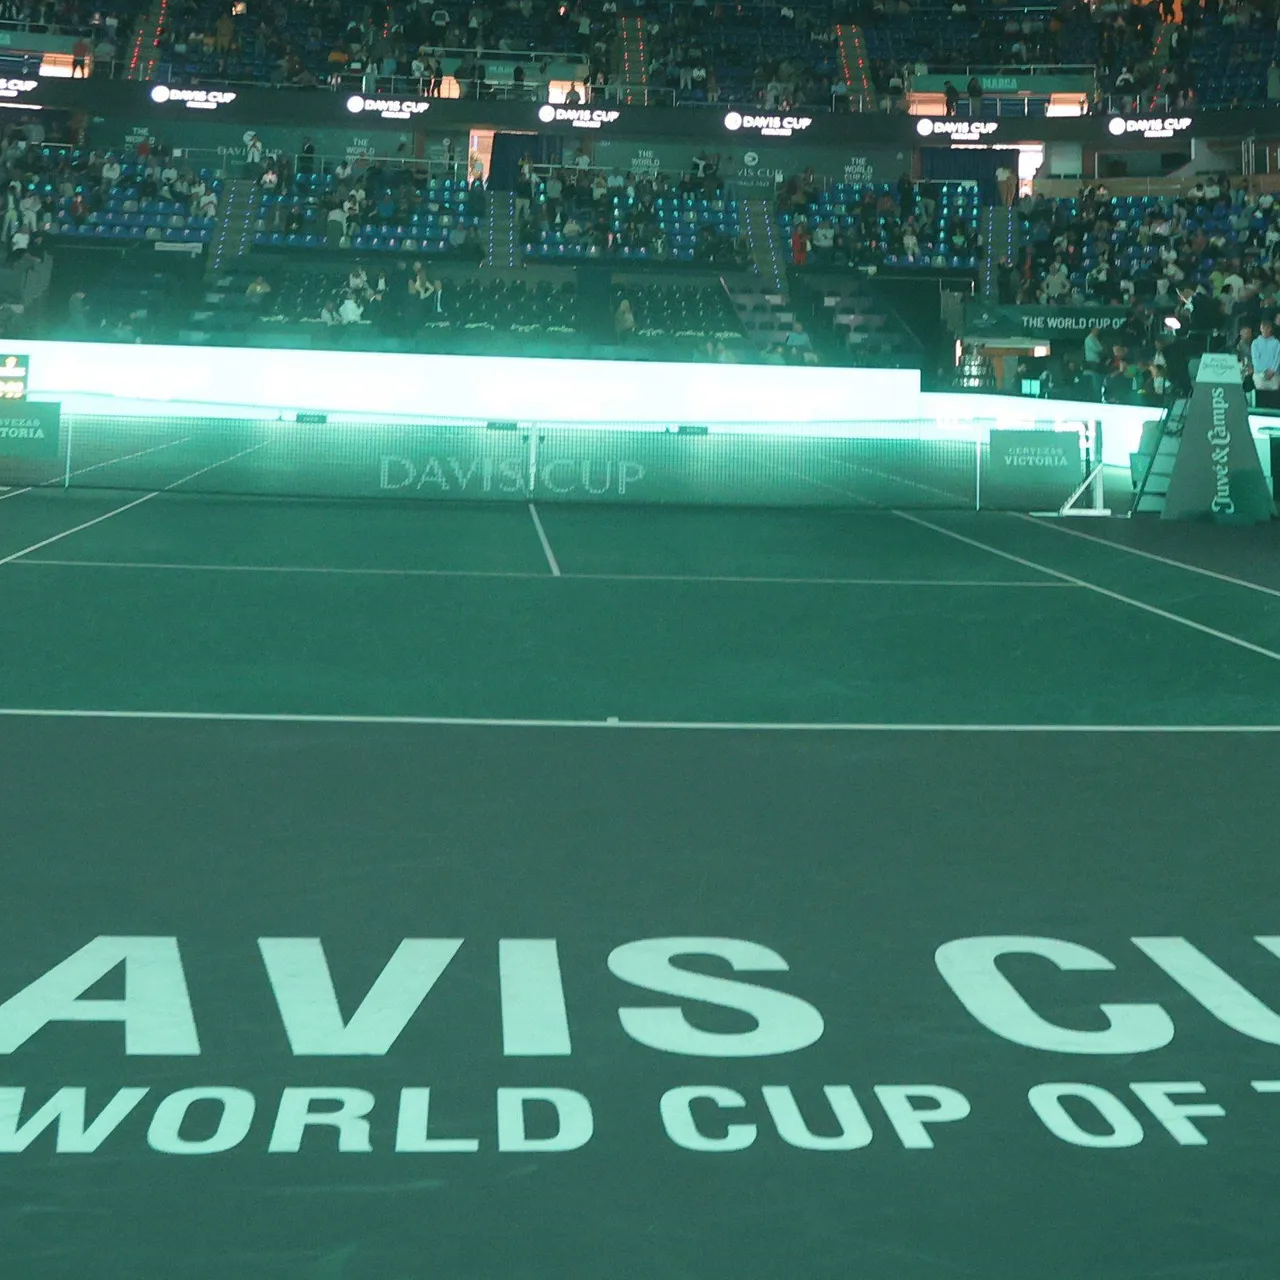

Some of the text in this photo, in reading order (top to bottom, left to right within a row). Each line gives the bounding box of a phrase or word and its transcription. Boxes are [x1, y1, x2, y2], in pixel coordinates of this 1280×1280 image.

[1022, 316, 1044, 329] THE
[1046, 317, 1087, 330] WORLD
[1004, 455, 1069, 467] VICTORIA
[380, 455, 647, 495] DAVIS CUP
[660, 1085, 970, 1151] CUP
[1028, 1082, 1225, 1147] OF
